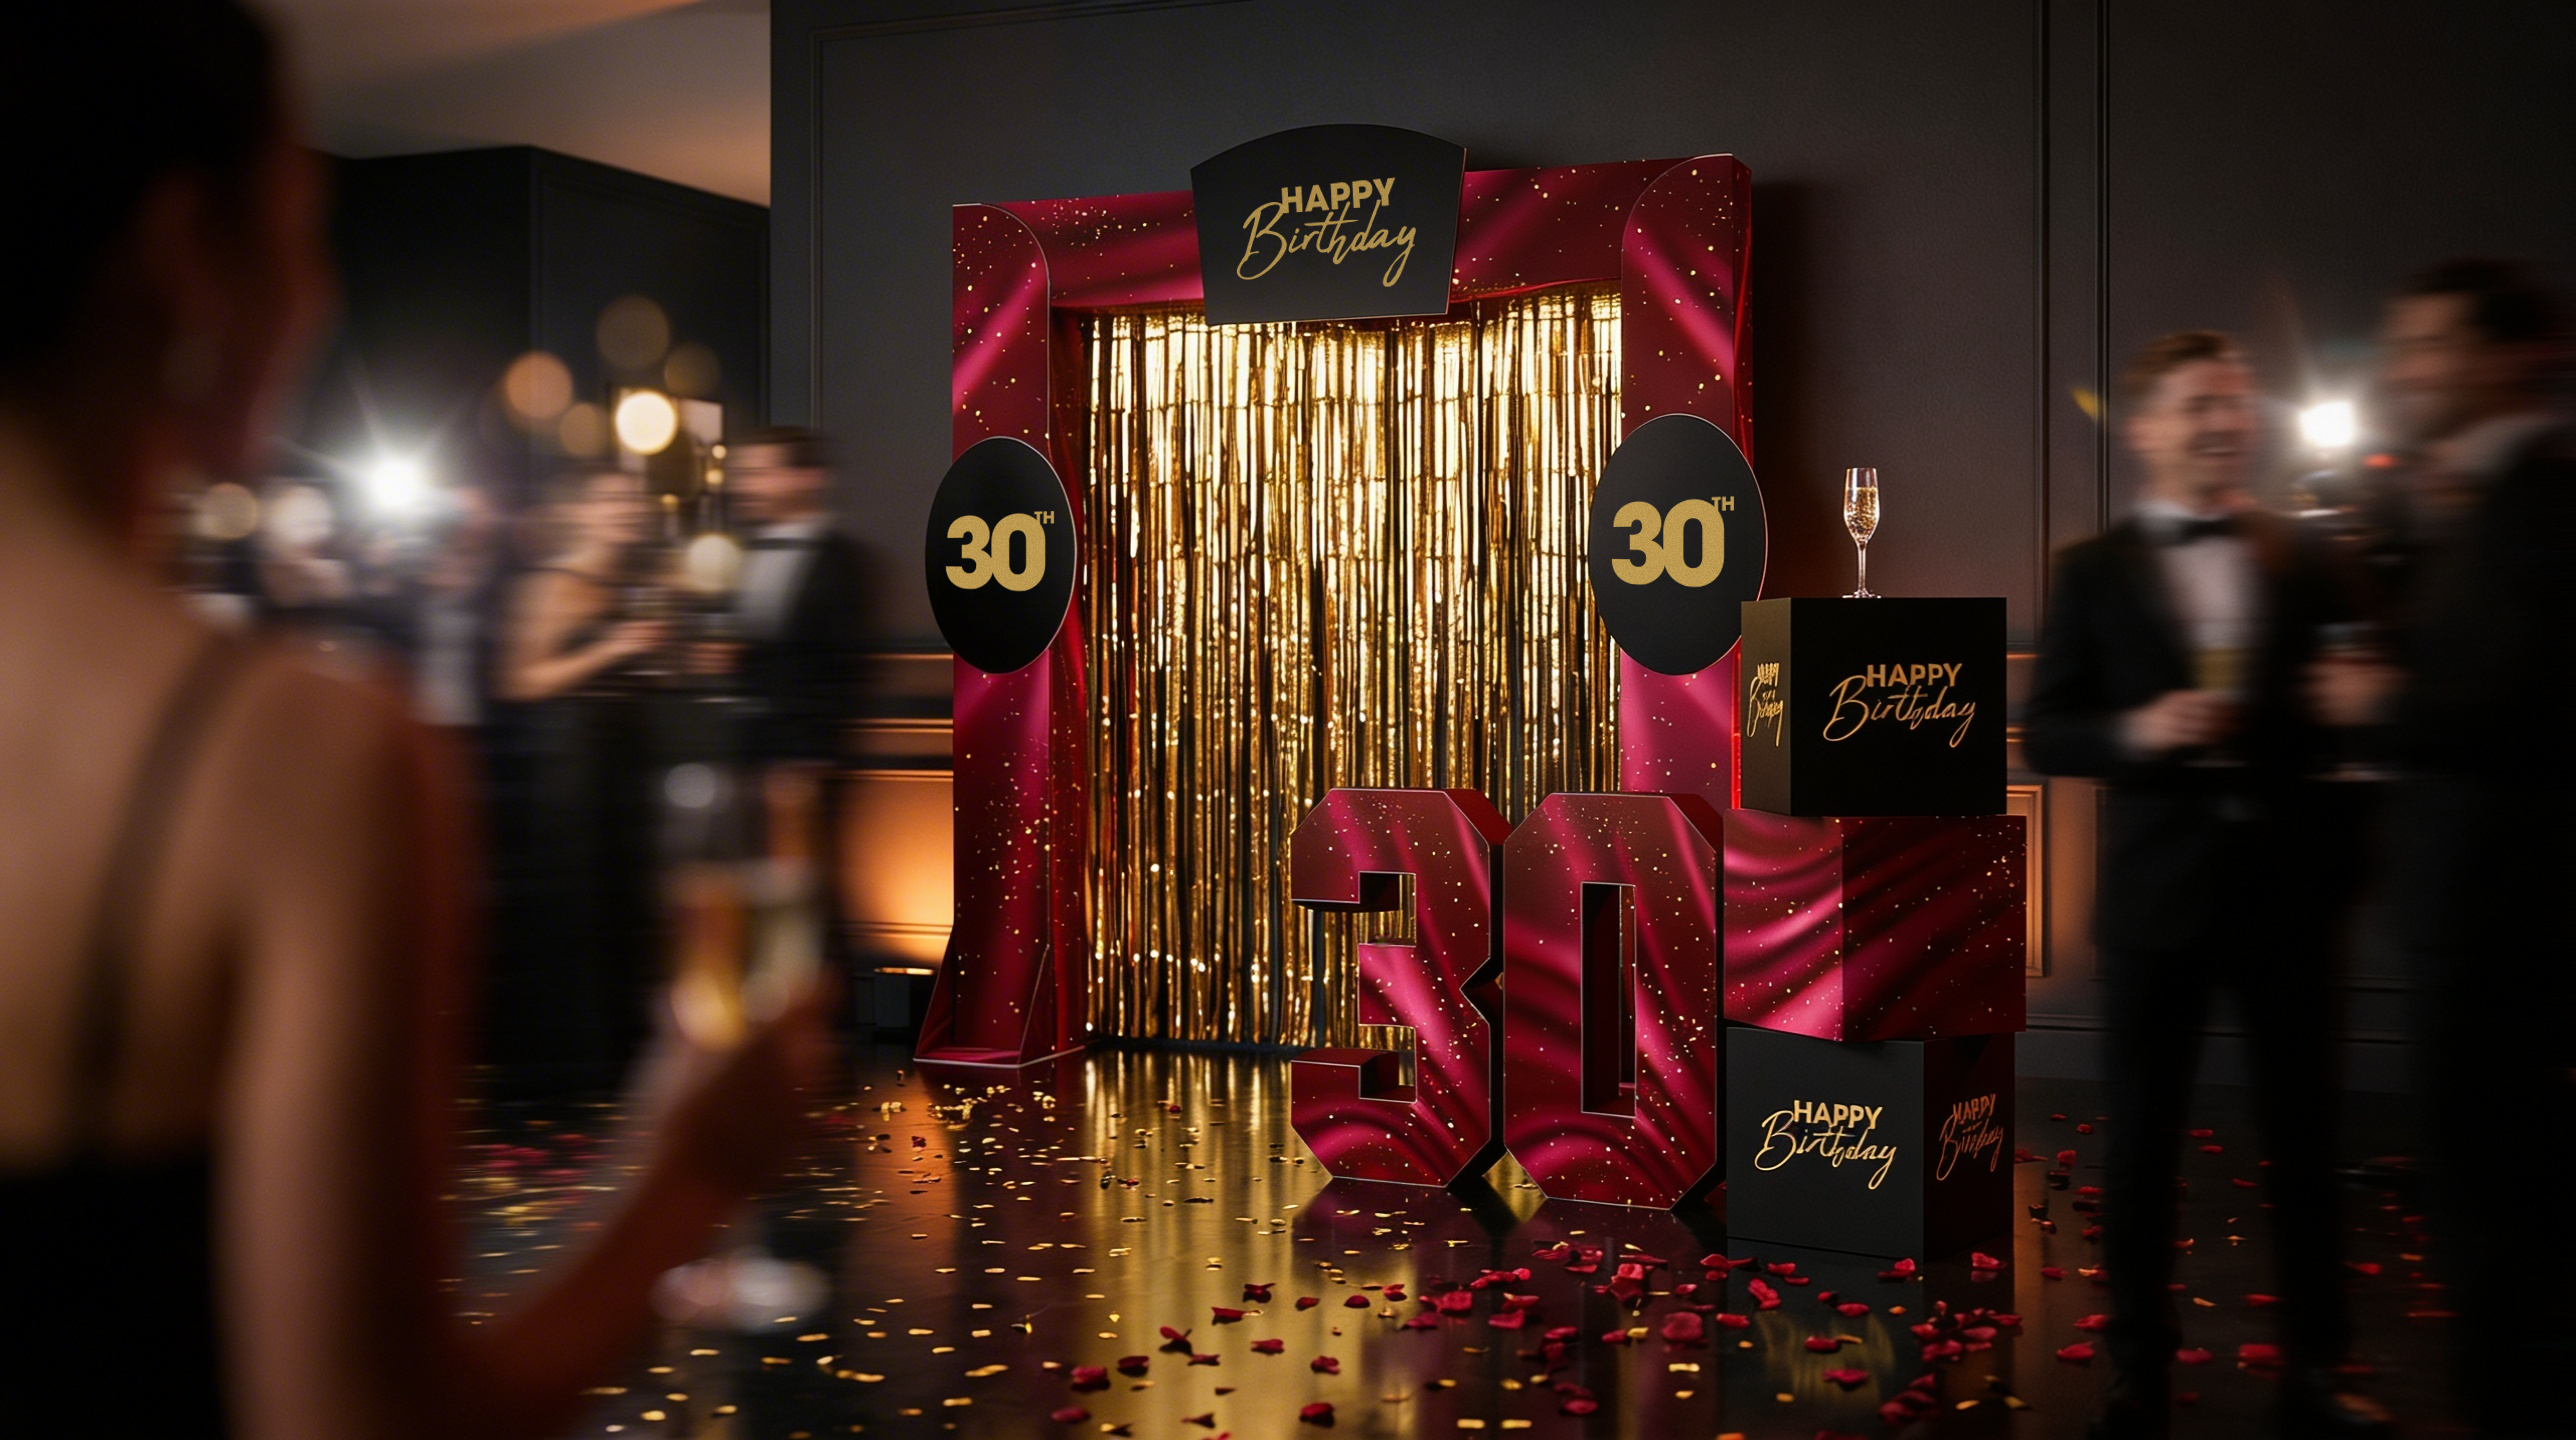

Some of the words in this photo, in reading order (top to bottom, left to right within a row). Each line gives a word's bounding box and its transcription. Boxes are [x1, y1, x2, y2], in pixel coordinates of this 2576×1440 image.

[1281, 177, 1395, 214] HAPPY
[1236, 201, 1416, 287] Birthday
[1866, 663, 1963, 688] HAPPY
[1793, 1100, 1883, 1130] HAPPY
